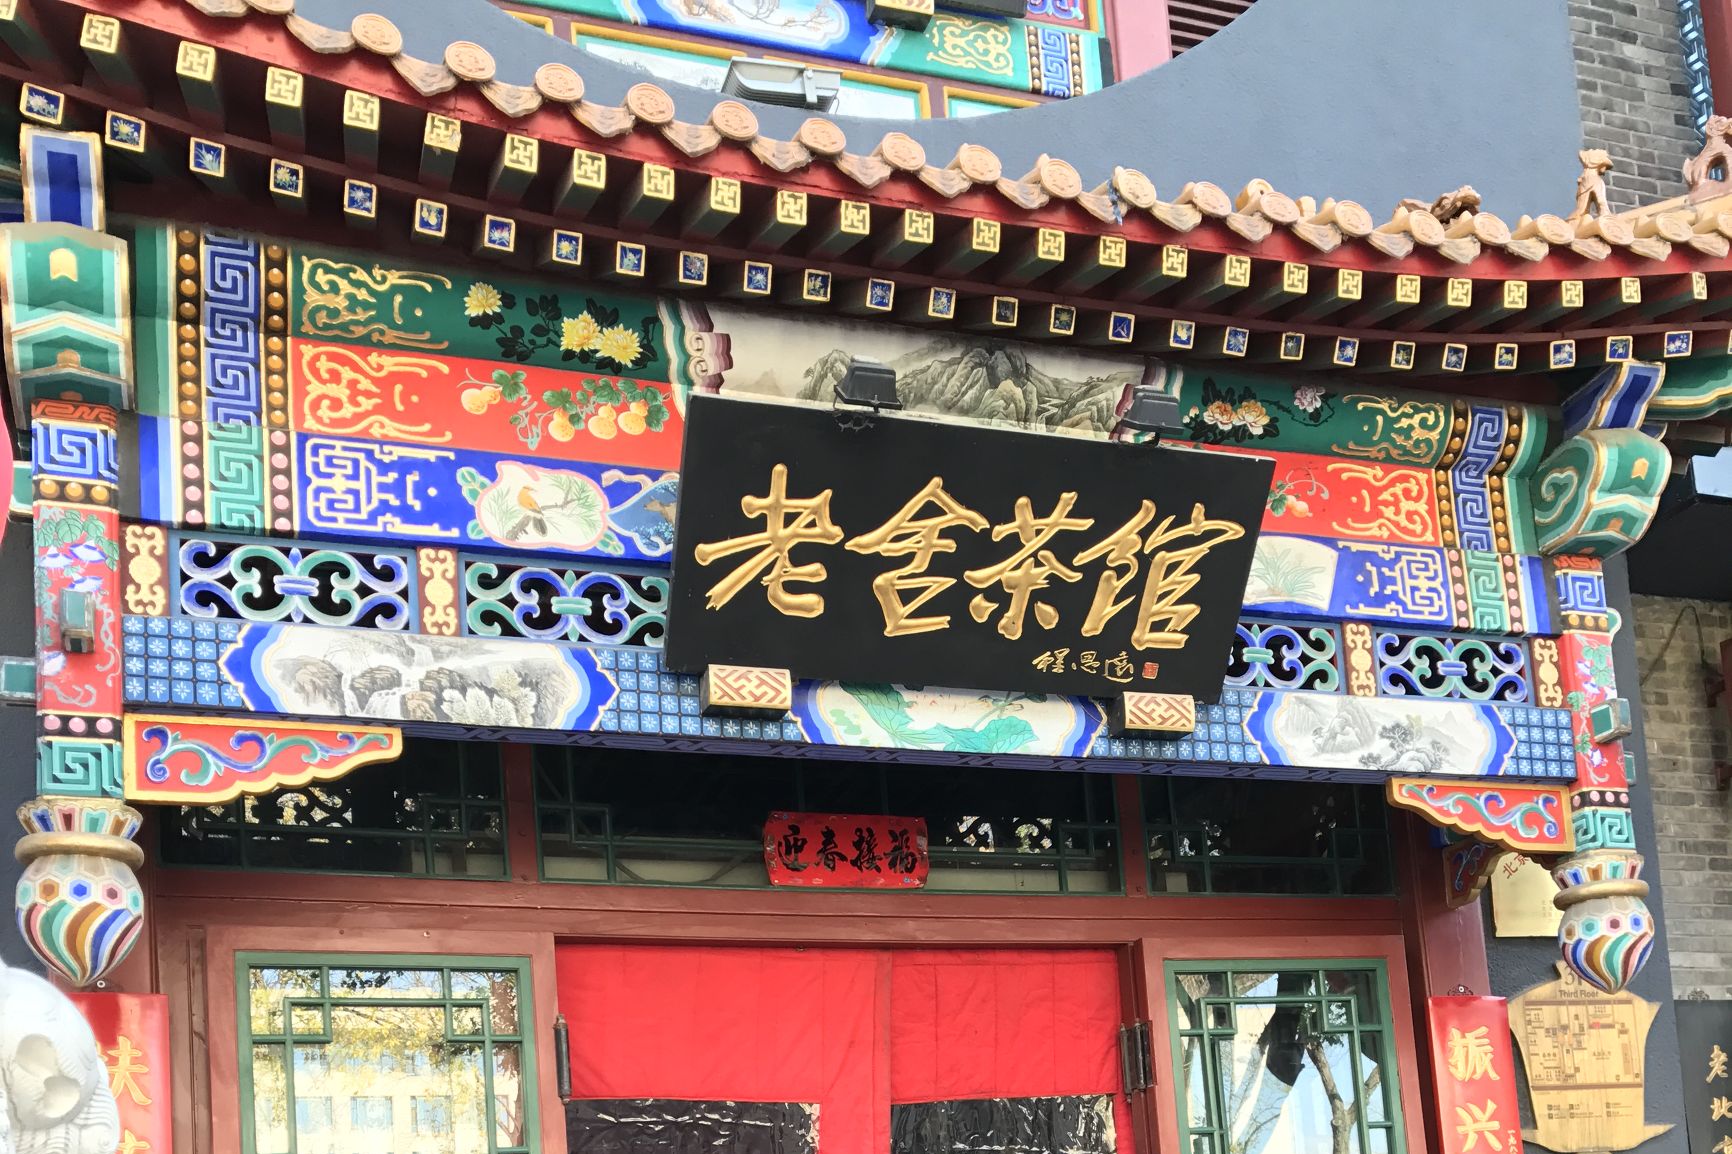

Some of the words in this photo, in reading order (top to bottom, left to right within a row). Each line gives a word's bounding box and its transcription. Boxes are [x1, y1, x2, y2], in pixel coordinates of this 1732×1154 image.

[695, 463, 1245, 651] 老舍茶馆
[777, 823, 919, 874] 迎春接福
[1558, 989, 1584, 999] Third
